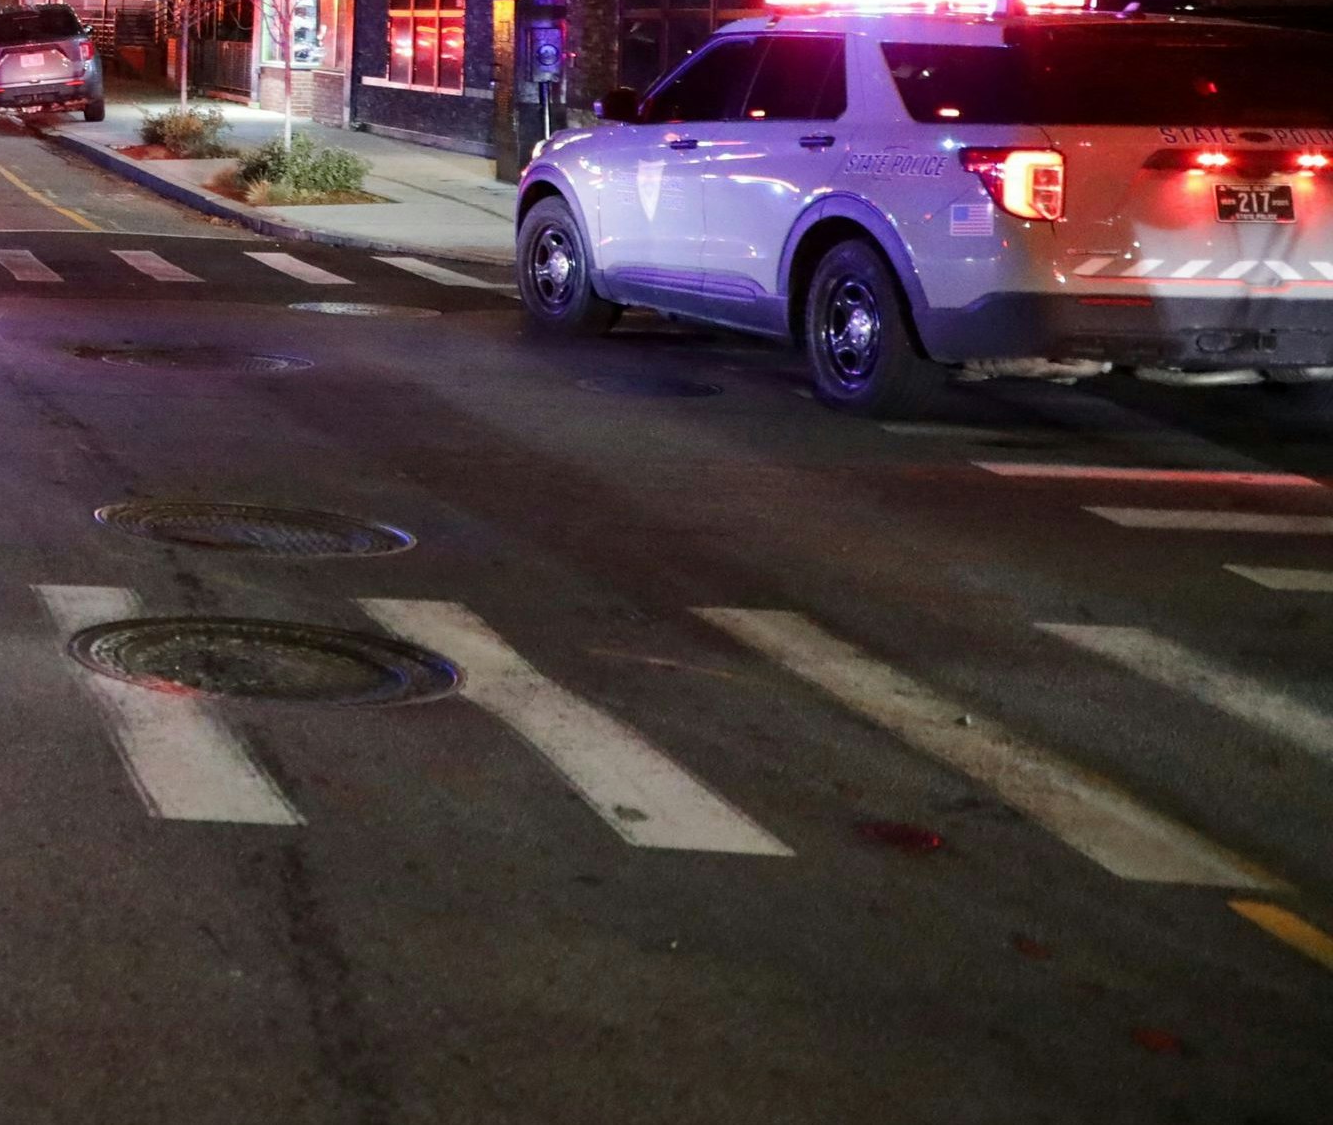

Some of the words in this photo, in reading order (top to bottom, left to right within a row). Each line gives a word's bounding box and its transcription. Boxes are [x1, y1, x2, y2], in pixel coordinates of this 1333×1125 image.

[1159, 127, 1236, 145] STATE
[844, 154, 891, 174] STATE
[891, 155, 949, 177] POLICE
[1237, 192, 1270, 213] 217
